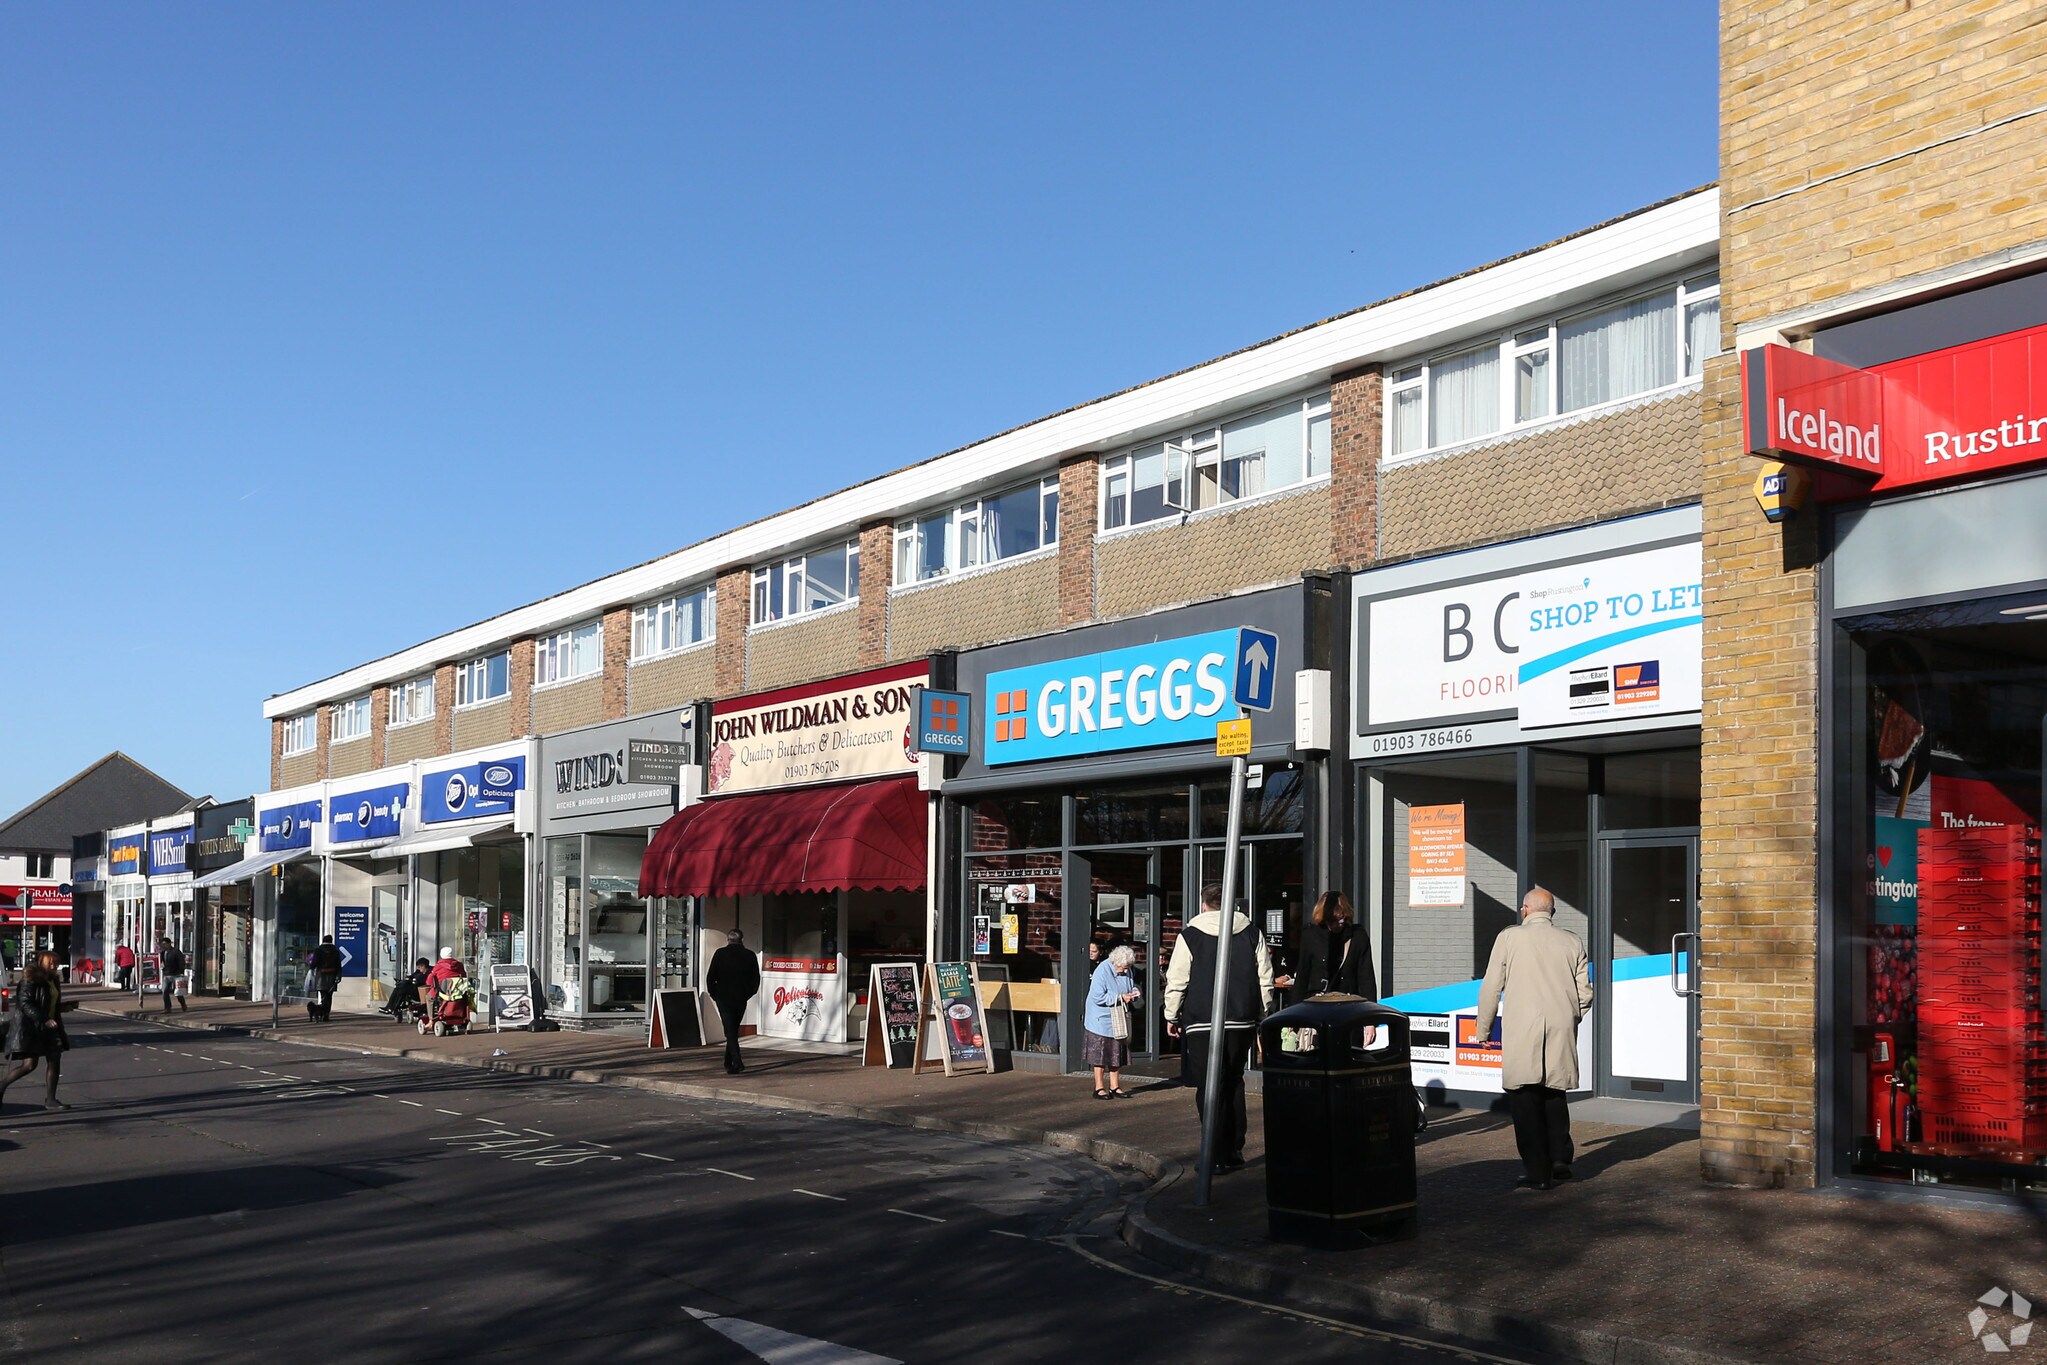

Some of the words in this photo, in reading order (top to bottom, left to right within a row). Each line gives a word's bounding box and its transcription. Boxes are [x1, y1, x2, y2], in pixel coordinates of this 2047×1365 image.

[1778, 397, 1880, 464] Iceland
[1924, 414, 2047, 464] Rustin
[1763, 474, 1787, 493] ADT
[1530, 600, 1598, 631] SHOP
[1606, 593, 1643, 619] TO
[1651, 583, 1702, 612] LET
[1037, 652, 1226, 738] GREGGS
[1441, 673, 1519, 700] FLOORI
[1636, 690, 1657, 698] 229200
[713, 714, 756, 748] JOHN
[761, 697, 848, 735] WILDMAN
[852, 694, 870, 718] &
[874, 683, 924, 717] SON
[741, 744, 774, 767] Quality
[777, 737, 816, 759] Butchers
[819, 733, 829, 752] &
[832, 729, 893, 751] Delicatessen
[925, 732, 963, 746] GREGGS
[1373, 735, 1414, 752] 01903
[1420, 729, 1472, 748] 786466
[631, 742, 686, 756] WINDSOR
[784, 763, 808, 779] 01903
[810, 760, 839, 776] 786708
[483, 789, 514, 797] Opticians
[578, 796, 605, 807] BATHROOM
[611, 792, 636, 803] BEDROOM
[638, 788, 669, 799] SHOWROOM
[334, 812, 353, 825] pharmacy
[374, 804, 388, 817] beauty
[1411, 810, 1432, 823] We're
[1434, 808, 1463, 824] Moving!
[942, 975, 961, 989] LATTE
[894, 991, 915, 1001] TAKEN
[1468, 1035, 1480, 1043] SH
[1423, 1050, 1445, 1058] 220033
[1459, 1053, 1480, 1061] 01903
